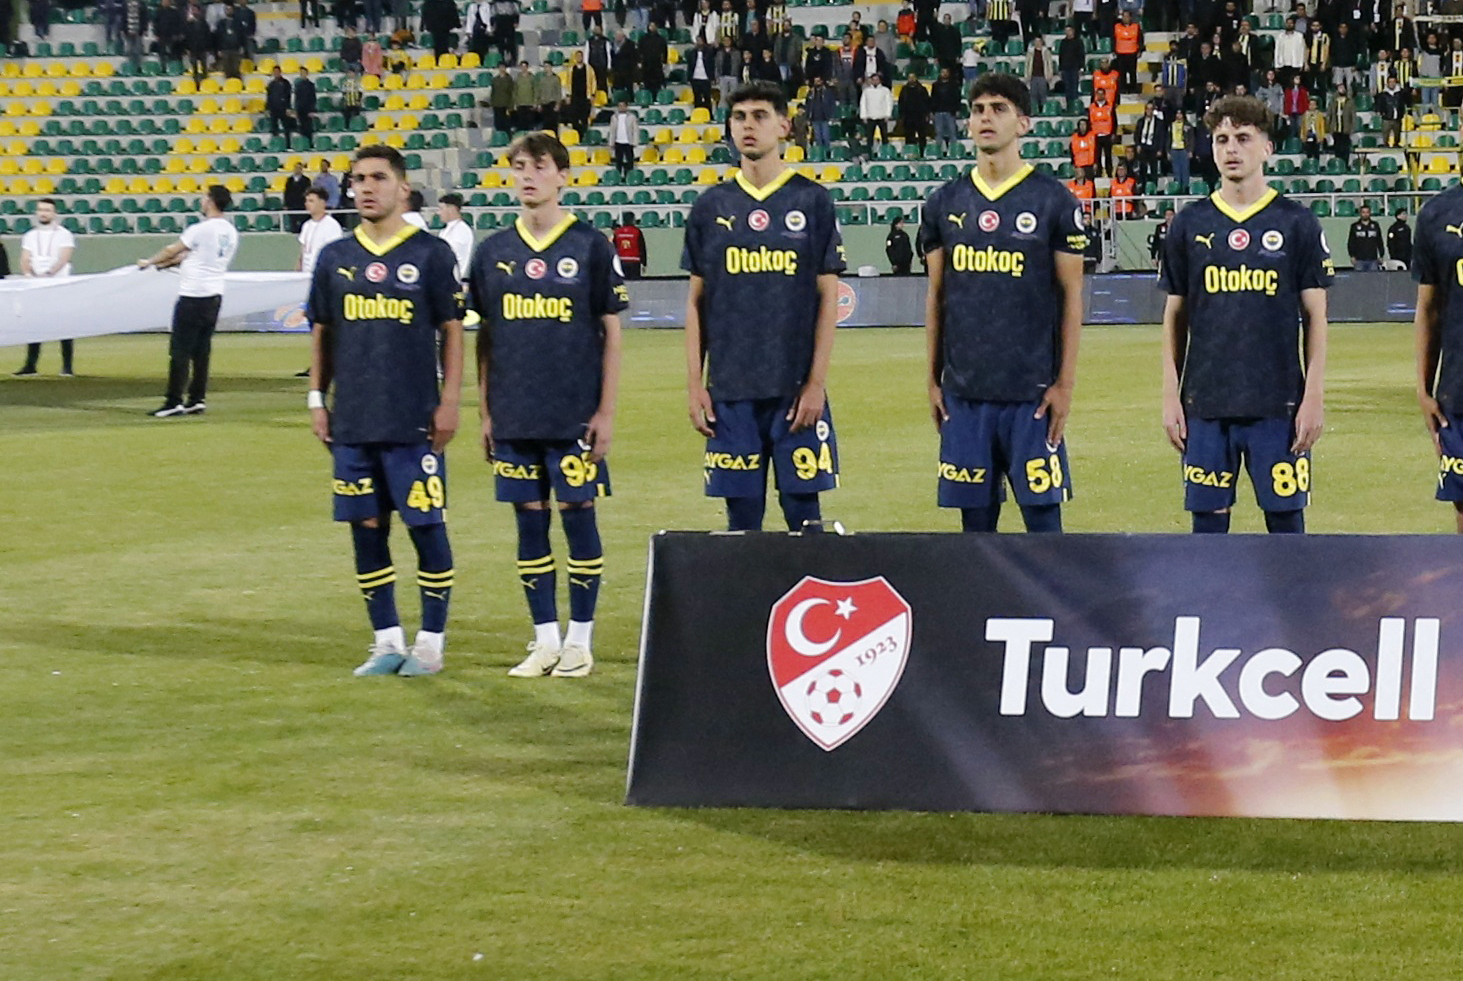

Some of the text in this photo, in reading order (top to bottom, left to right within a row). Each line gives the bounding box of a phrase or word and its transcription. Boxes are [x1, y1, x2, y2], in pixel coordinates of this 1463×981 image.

[726, 245, 798, 276] Otokoç
[953, 244, 1025, 277] Otokoç
[1204, 265, 1278, 295] Otokoç
[343, 293, 414, 324] Otokoç
[503, 293, 573, 322] Otokoç
[792, 442, 833, 480] 94
[938, 460, 986, 483] YGAZ
[1026, 454, 1063, 493] 58
[1271, 457, 1309, 497] 88
[406, 475, 444, 512] 49
[855, 636, 898, 667] 1923
[984, 616, 1440, 722] Turkcell
